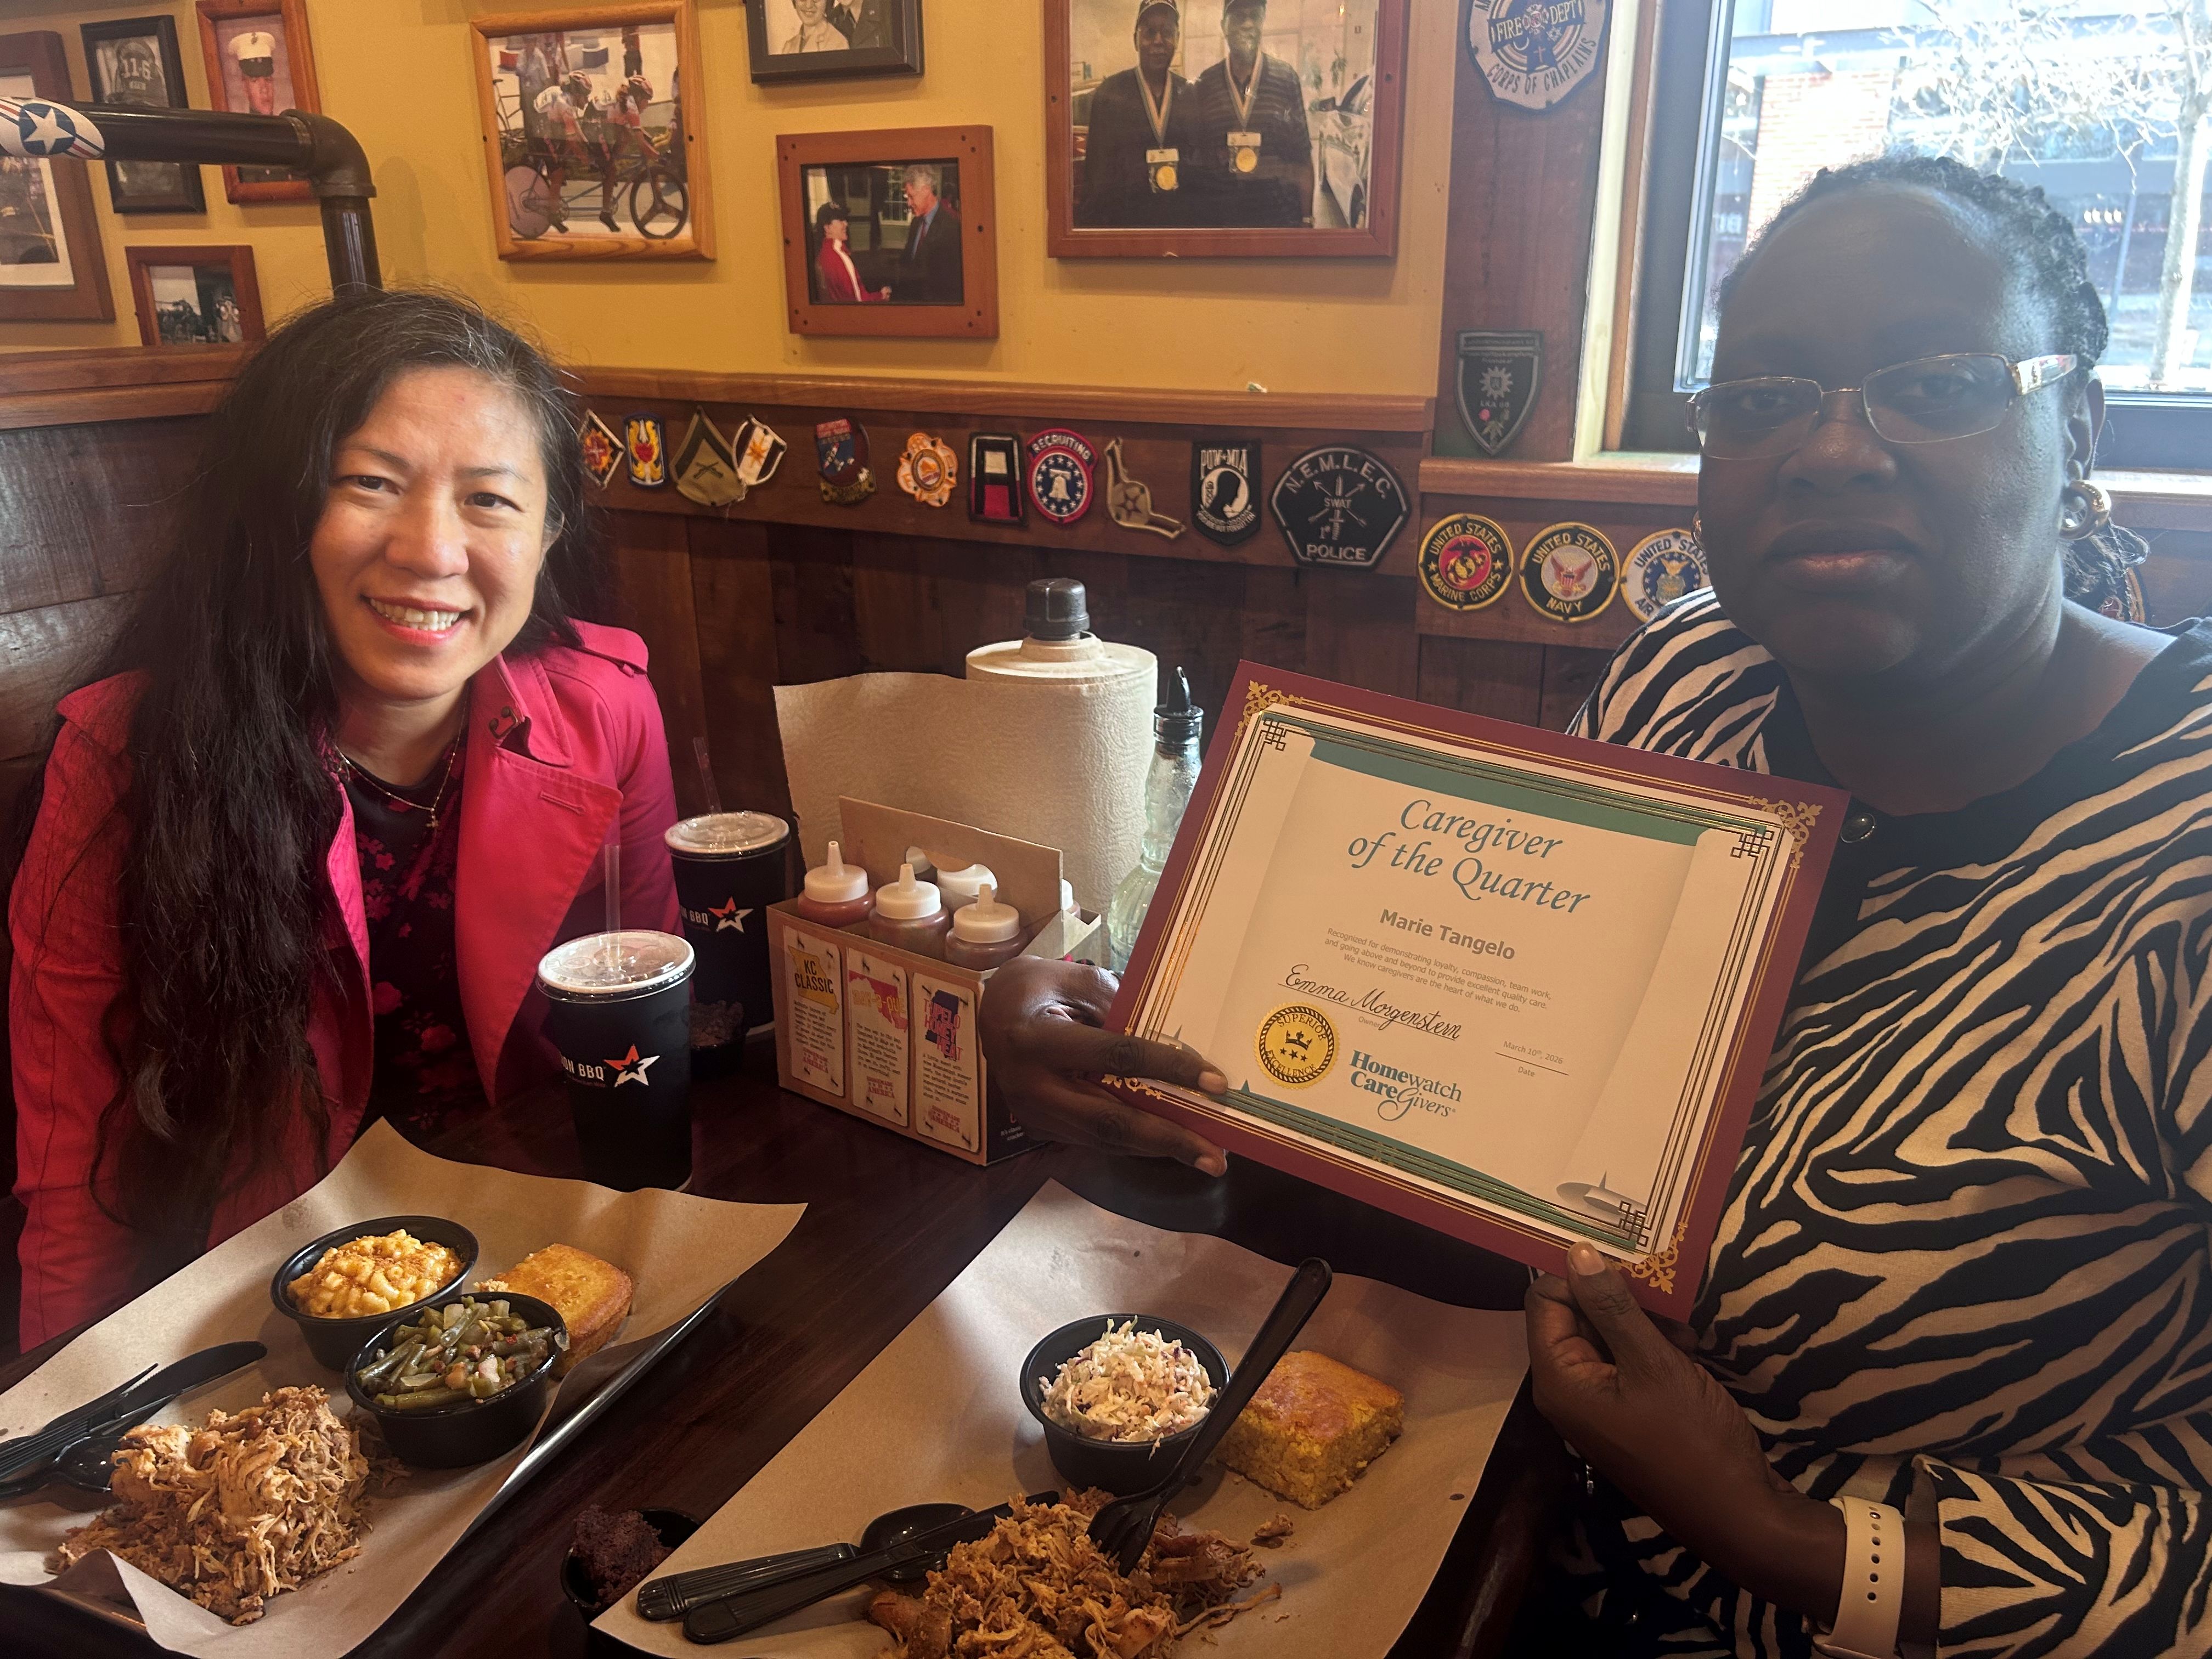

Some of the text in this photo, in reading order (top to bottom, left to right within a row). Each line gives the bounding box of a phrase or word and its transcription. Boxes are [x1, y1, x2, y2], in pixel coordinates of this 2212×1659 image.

[1496, 0, 1577, 42] FIRE DEPT
[1487, 37, 1596, 94] CORPS OF CHAPLAINS
[1032, 434, 1091, 460] RECRUITING
[1285, 454, 1391, 499] N.E.M.L.E.C.
[1324, 497, 1352, 509] SWAT
[1306, 544, 1366, 560] POLICE
[1429, 522, 1502, 555] UNITED STATES
[1532, 532, 1611, 572] UNITED STATES
[1634, 538, 1672, 568] UNITED
[1430, 571, 1502, 602] MARINE CORPS
[1546, 596, 1582, 614] NAVY
[1400, 799, 1563, 859] Caregiver
[1348, 832, 1590, 913] of the Quarter
[690, 910, 709, 926] BBQ
[1379, 909, 1515, 960] Marie Tangelo
[804, 960, 817, 975] KC
[1324, 938, 1547, 1009] and going above and beyond to provide excellent quality care.
[1327, 928, 1551, 1001] Recognized for demonstrating loyalty, compassion, team work,
[794, 973, 834, 994] CLASSIC
[1344, 953, 1355, 963] We
[1357, 957, 1376, 969] know
[1377, 964, 1414, 981] caregivers
[1415, 975, 1427, 985] are
[1429, 979, 1442, 989] the
[1443, 984, 1464, 996] heart
[1475, 994, 1494, 1005] what
[1496, 1000, 1508, 1008] we
[1509, 1003, 1520, 1012] do.
[924, 998, 961, 1029] TUPELO
[1286, 964, 1462, 1039] Emma Morgenstern
[924, 1014, 957, 1042] HONEY
[1277, 1013, 1327, 1041] SUPERIOR
[1358, 1015, 1381, 1029] Owner
[937, 1034, 963, 1060] HEAT
[1503, 1041, 1526, 1053] March
[1544, 1053, 1564, 1064] 2026
[578, 1063, 604, 1081] BBQ
[1265, 1049, 1317, 1077] EXCELLENCE
[1348, 1049, 1462, 1103] Homewatch
[1517, 1066, 1536, 1077] Date
[868, 1086, 895, 1098] AMERICA
[931, 1116, 960, 1133] AMERICA
